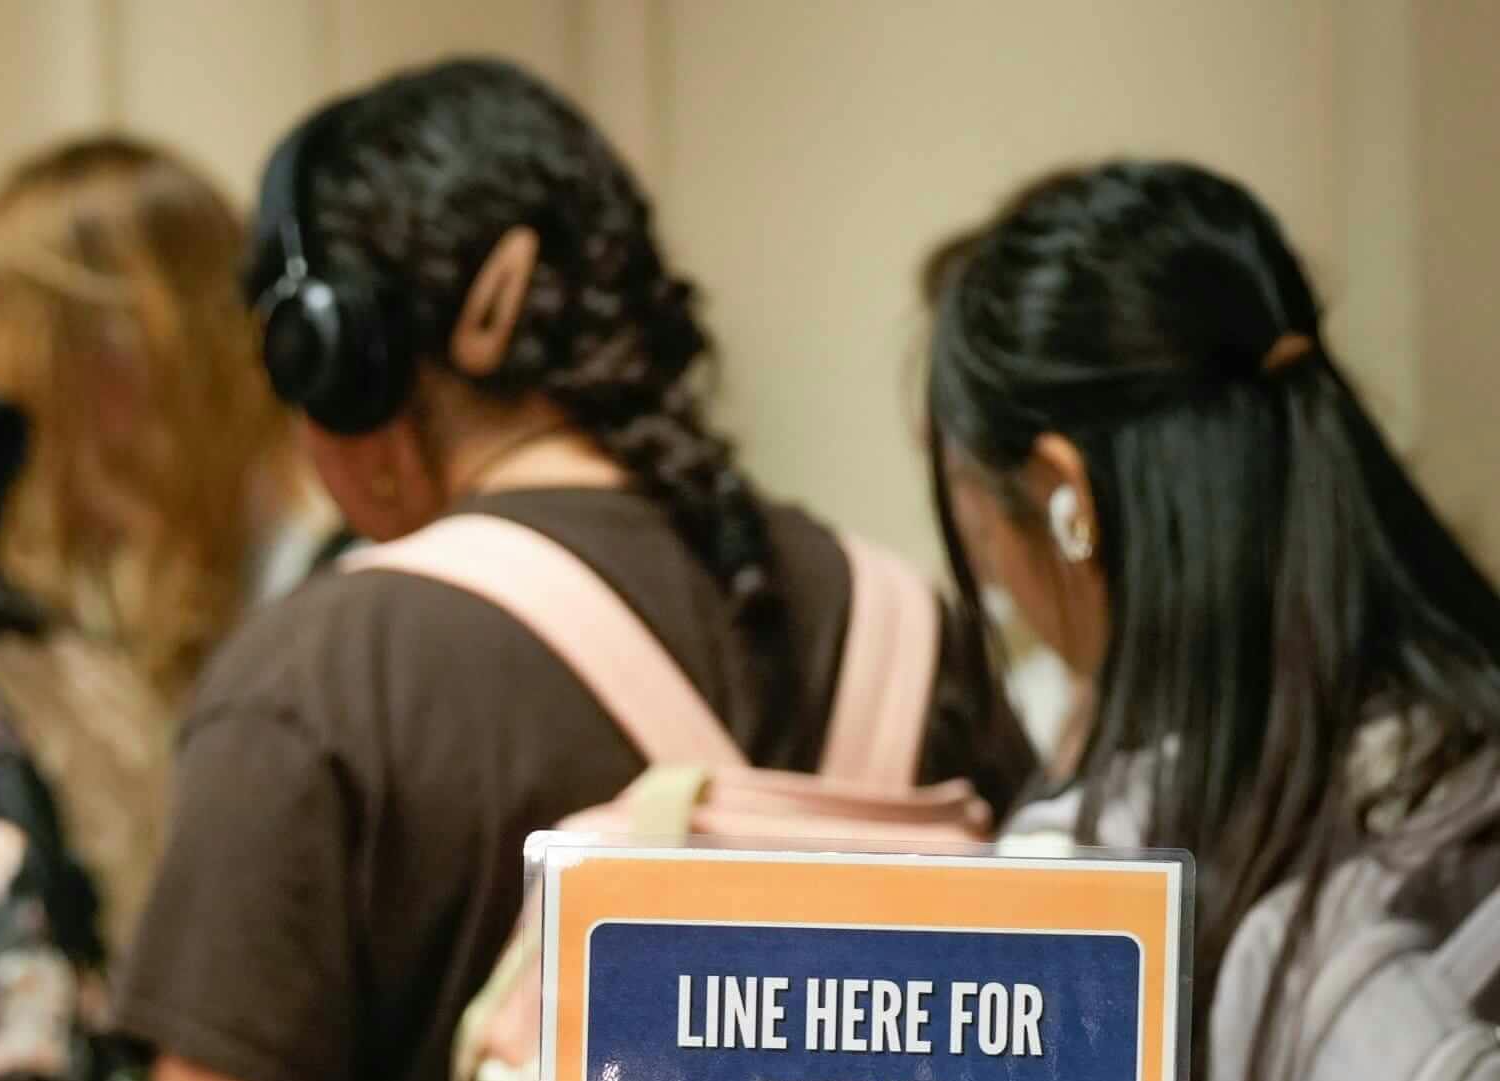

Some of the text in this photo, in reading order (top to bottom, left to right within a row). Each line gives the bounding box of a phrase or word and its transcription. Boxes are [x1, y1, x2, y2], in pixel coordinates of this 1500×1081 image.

[677, 975, 1044, 1056] LINE HERE FOR
